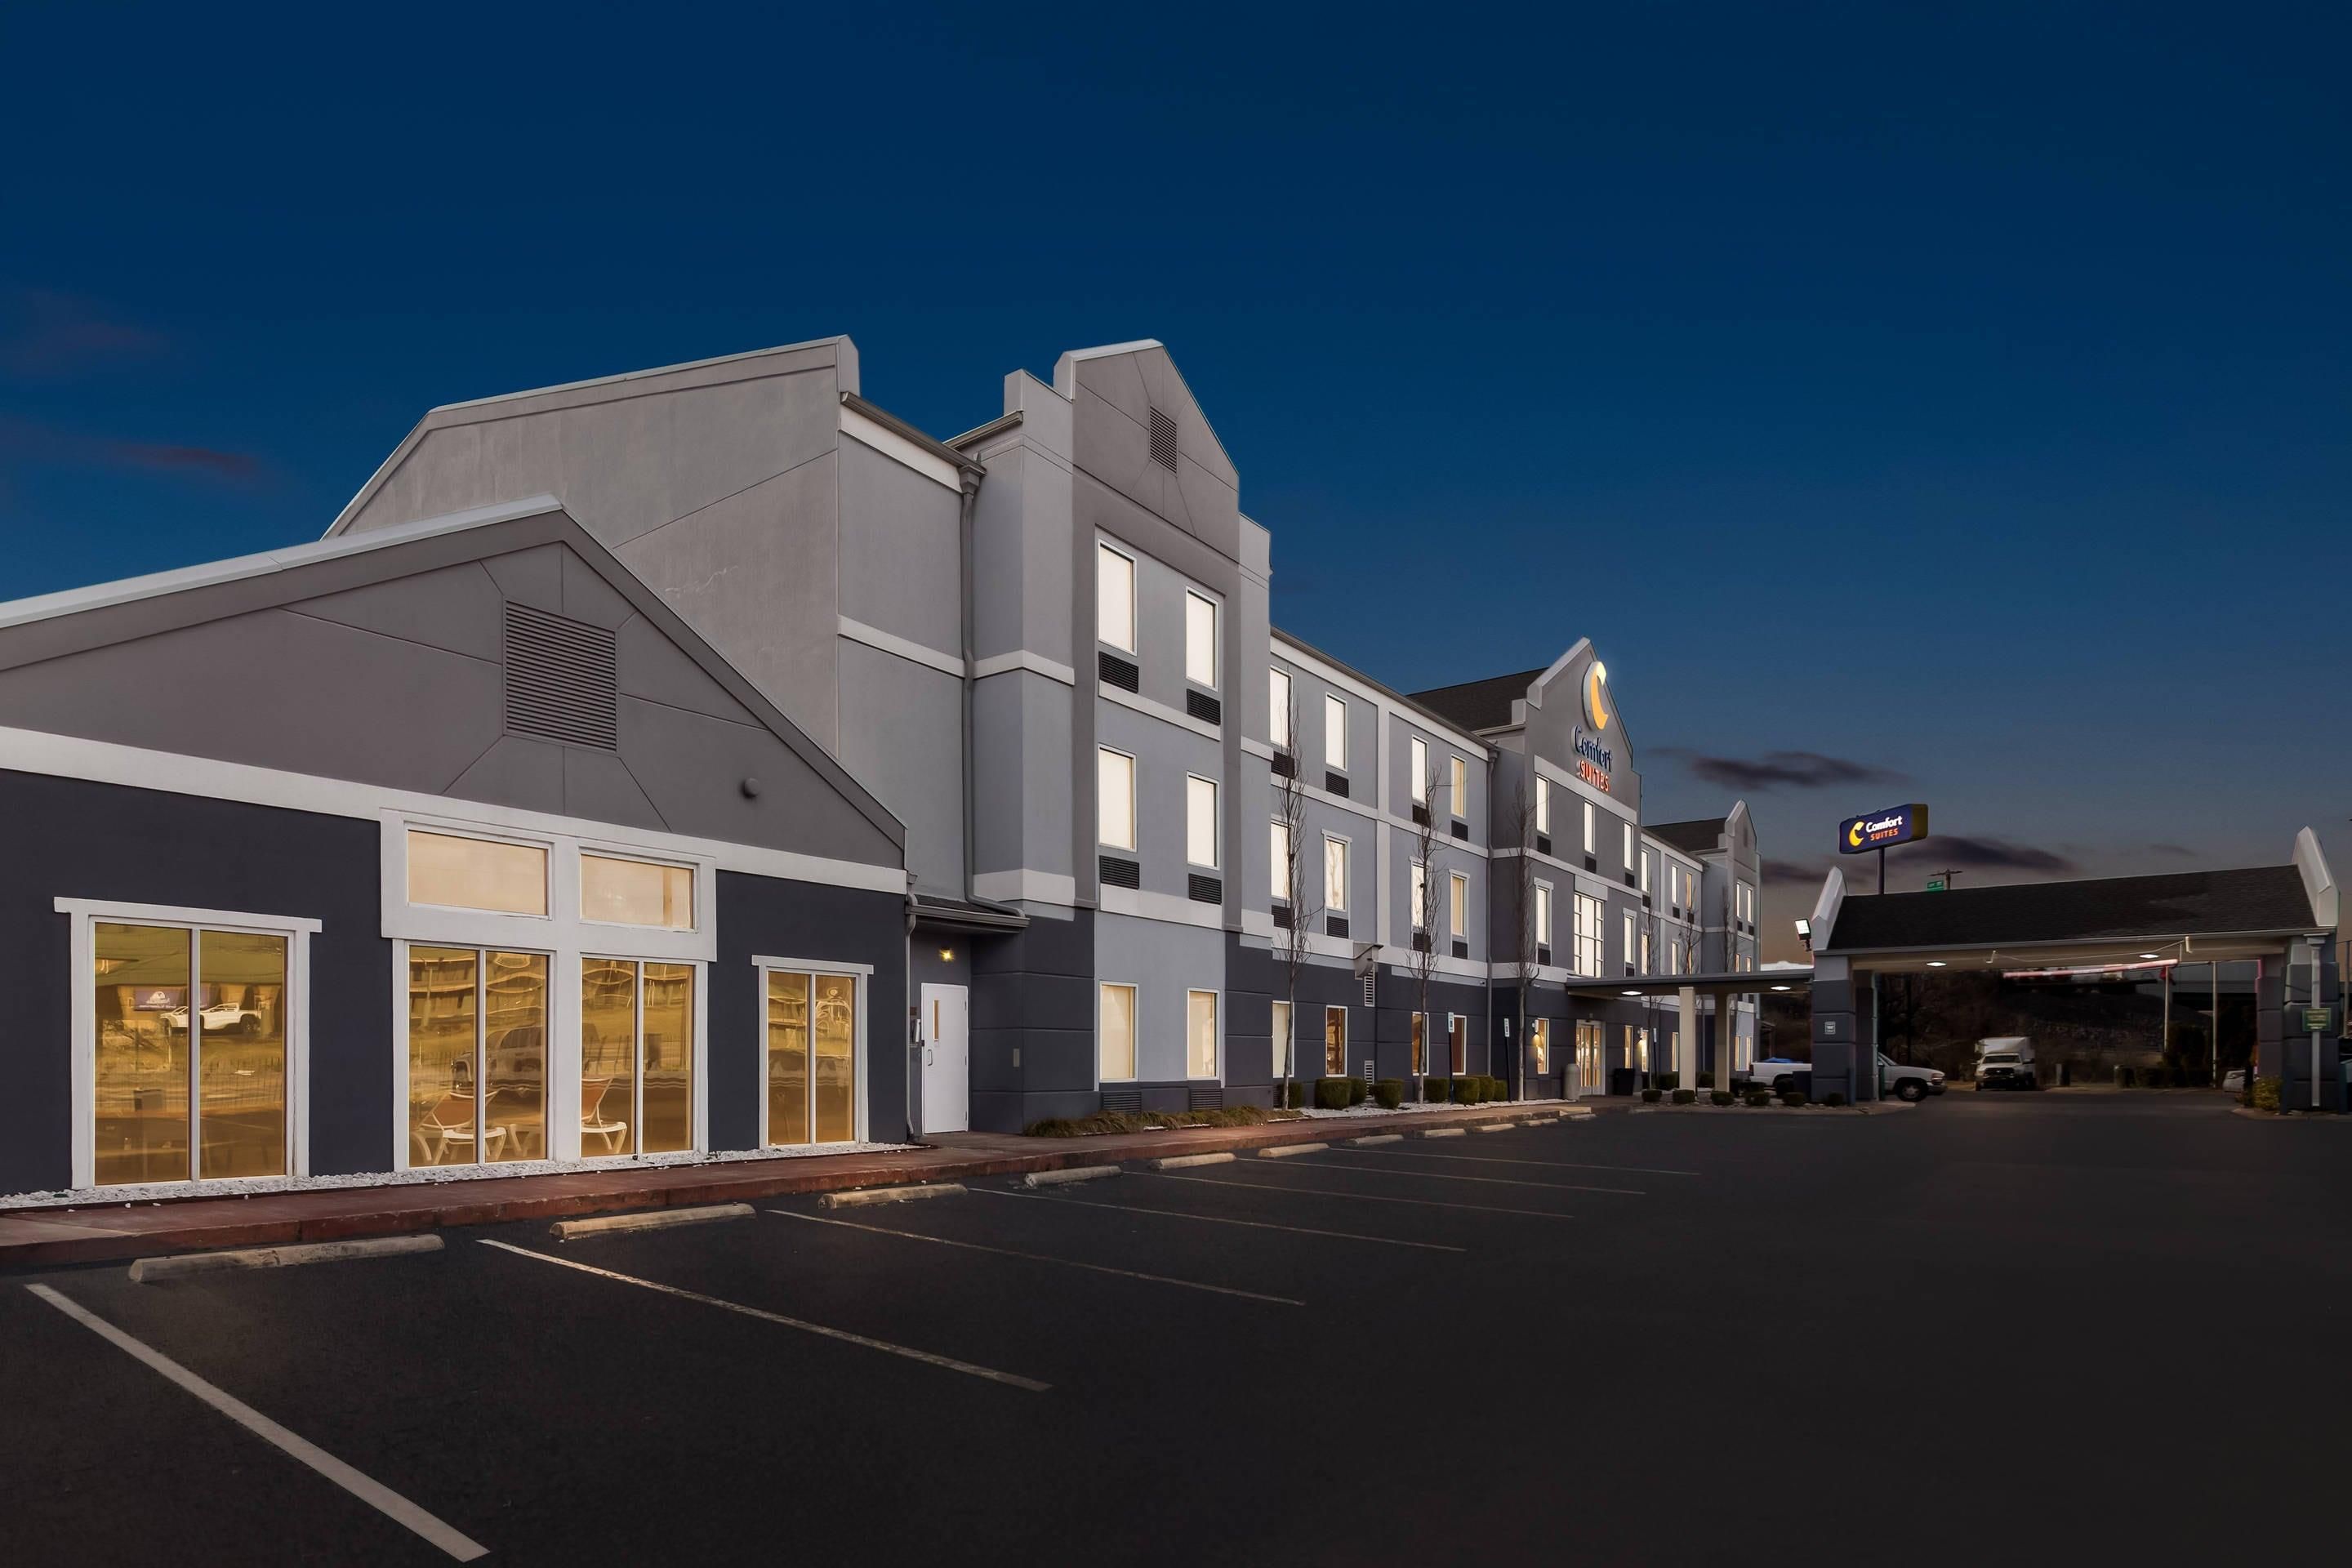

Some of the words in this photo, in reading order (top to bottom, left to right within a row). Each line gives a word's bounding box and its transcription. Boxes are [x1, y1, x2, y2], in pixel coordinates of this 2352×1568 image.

[1572, 725, 1612, 771] Comfort
[1579, 760, 1609, 791] SUITES
[1866, 816, 1902, 832] Comfort
[1870, 828, 1898, 840] SUITES
